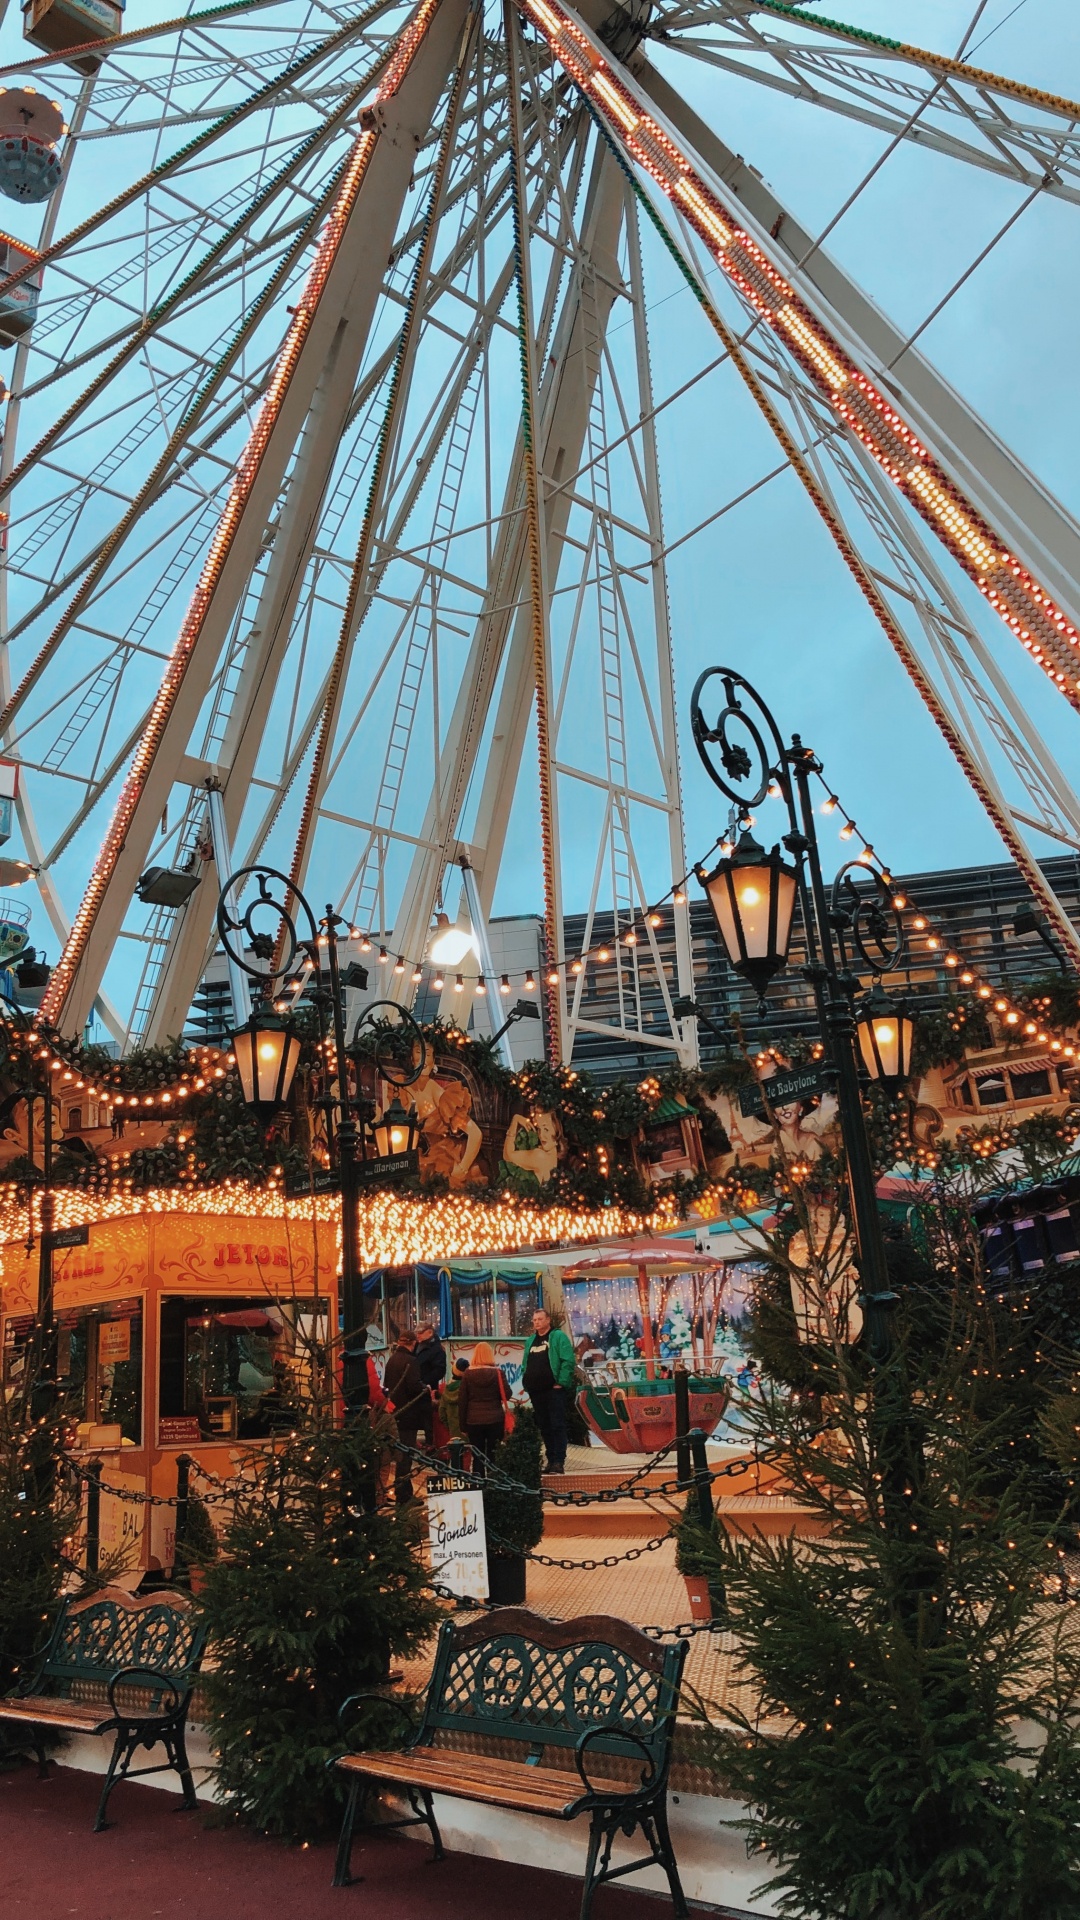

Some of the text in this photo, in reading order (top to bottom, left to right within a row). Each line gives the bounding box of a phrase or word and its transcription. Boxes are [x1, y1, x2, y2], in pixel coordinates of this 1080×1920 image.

[776, 1075, 817, 1096] Babylone
[373, 1160, 409, 1174] Marignan
[437, 1513, 478, 1550] Gondel
[453, 1550, 484, 1559] Personen
